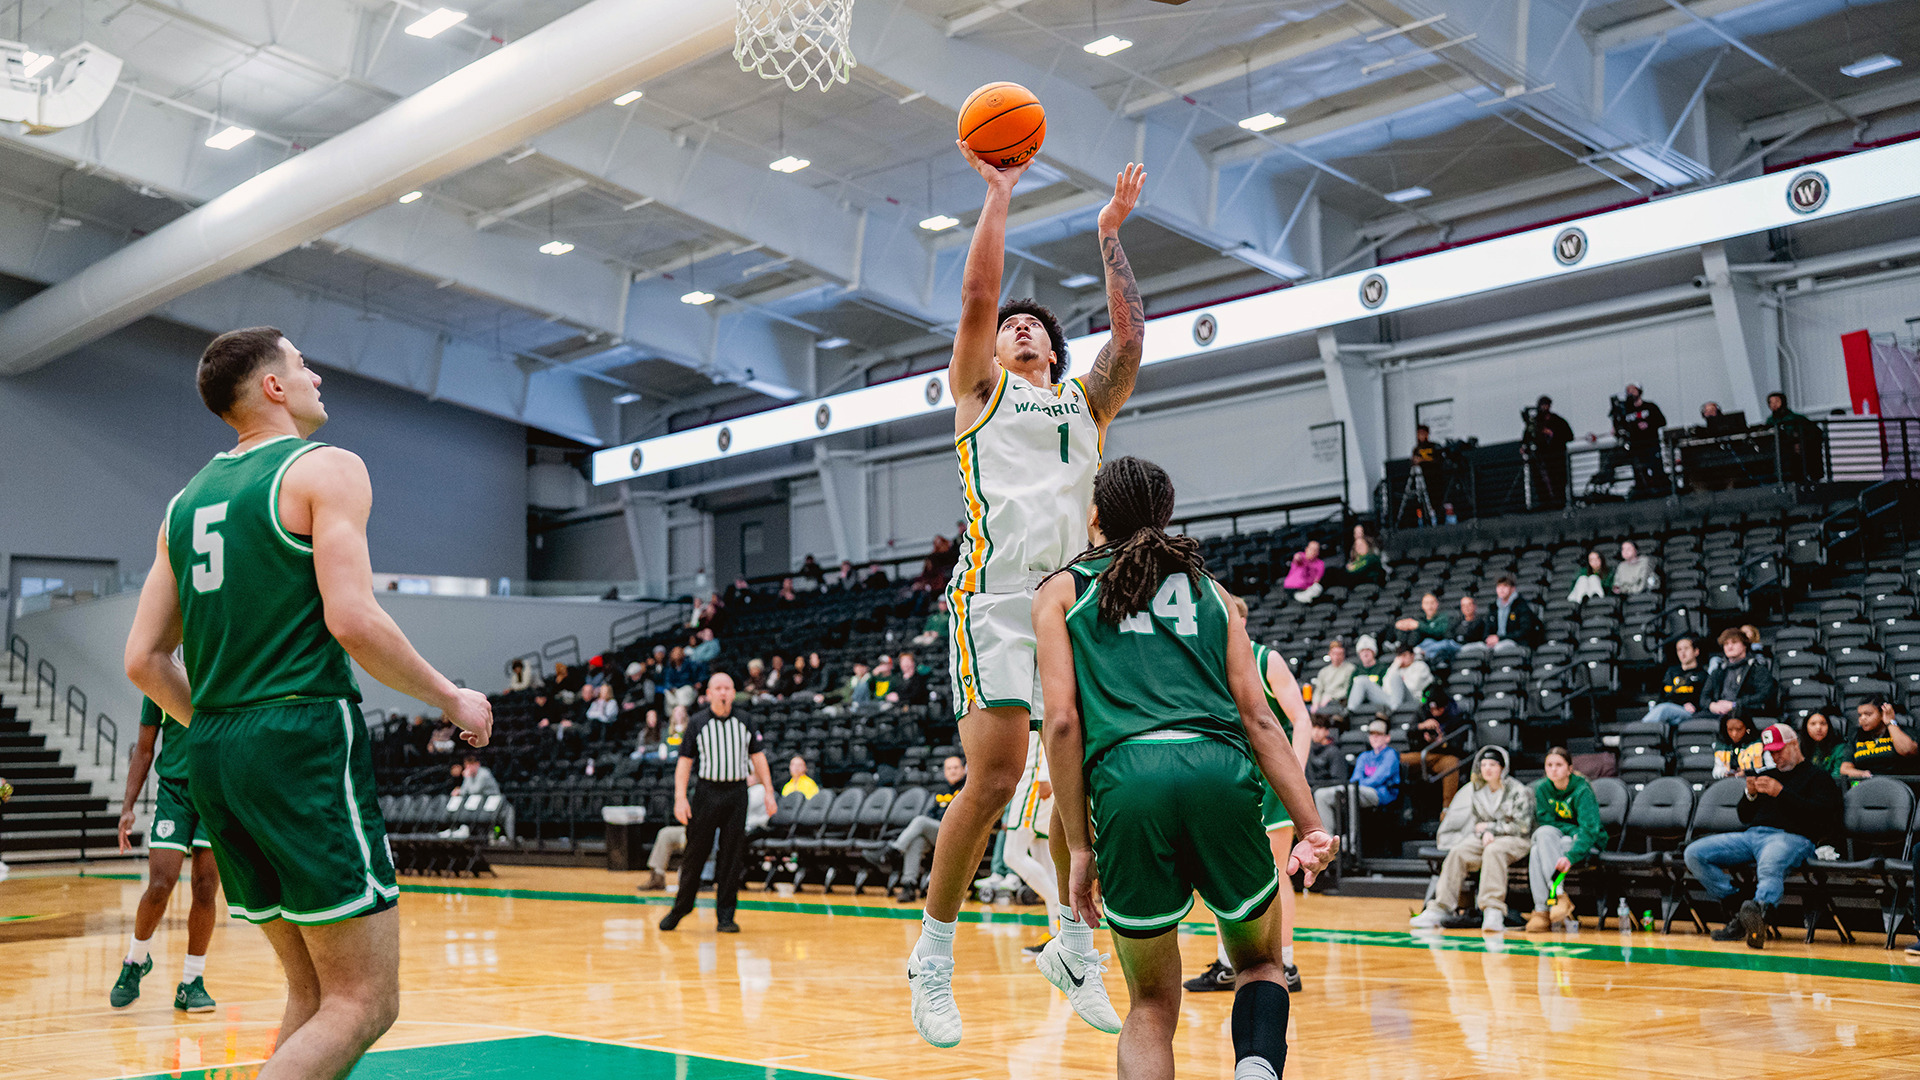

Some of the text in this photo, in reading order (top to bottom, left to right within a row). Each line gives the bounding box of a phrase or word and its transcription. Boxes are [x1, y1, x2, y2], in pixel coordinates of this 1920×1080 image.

[1001, 142, 1038, 166] NCAA
[1797, 181, 1817, 204] W
[1057, 422, 1069, 464] 1
[192, 501, 229, 593] 5
